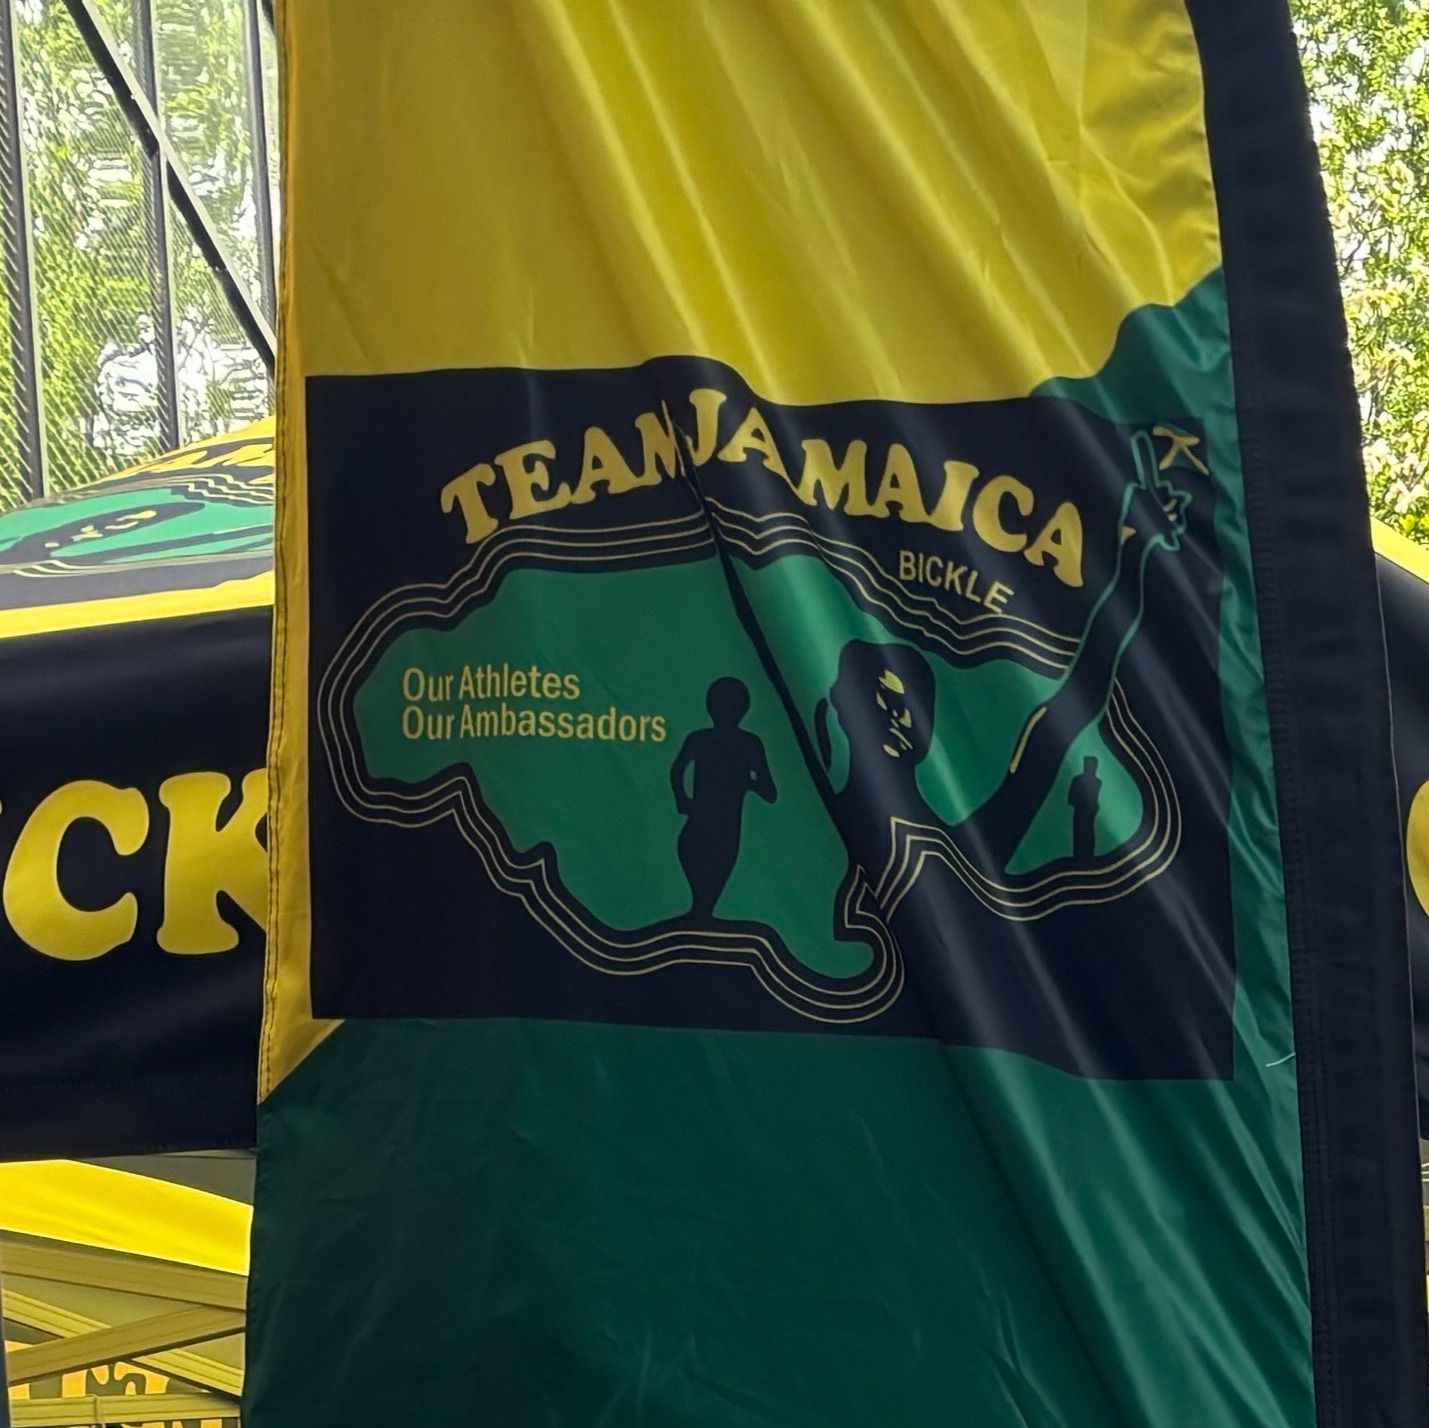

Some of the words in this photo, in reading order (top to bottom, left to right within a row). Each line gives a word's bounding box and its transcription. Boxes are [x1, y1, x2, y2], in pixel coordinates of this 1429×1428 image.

[684, 387, 1085, 588] JAMAICA
[897, 549, 1016, 614] BICKLE
[401, 666, 455, 702] Our
[457, 664, 581, 703] Athletes
[401, 706, 456, 743] Our
[457, 707, 667, 744] Ambassadors
